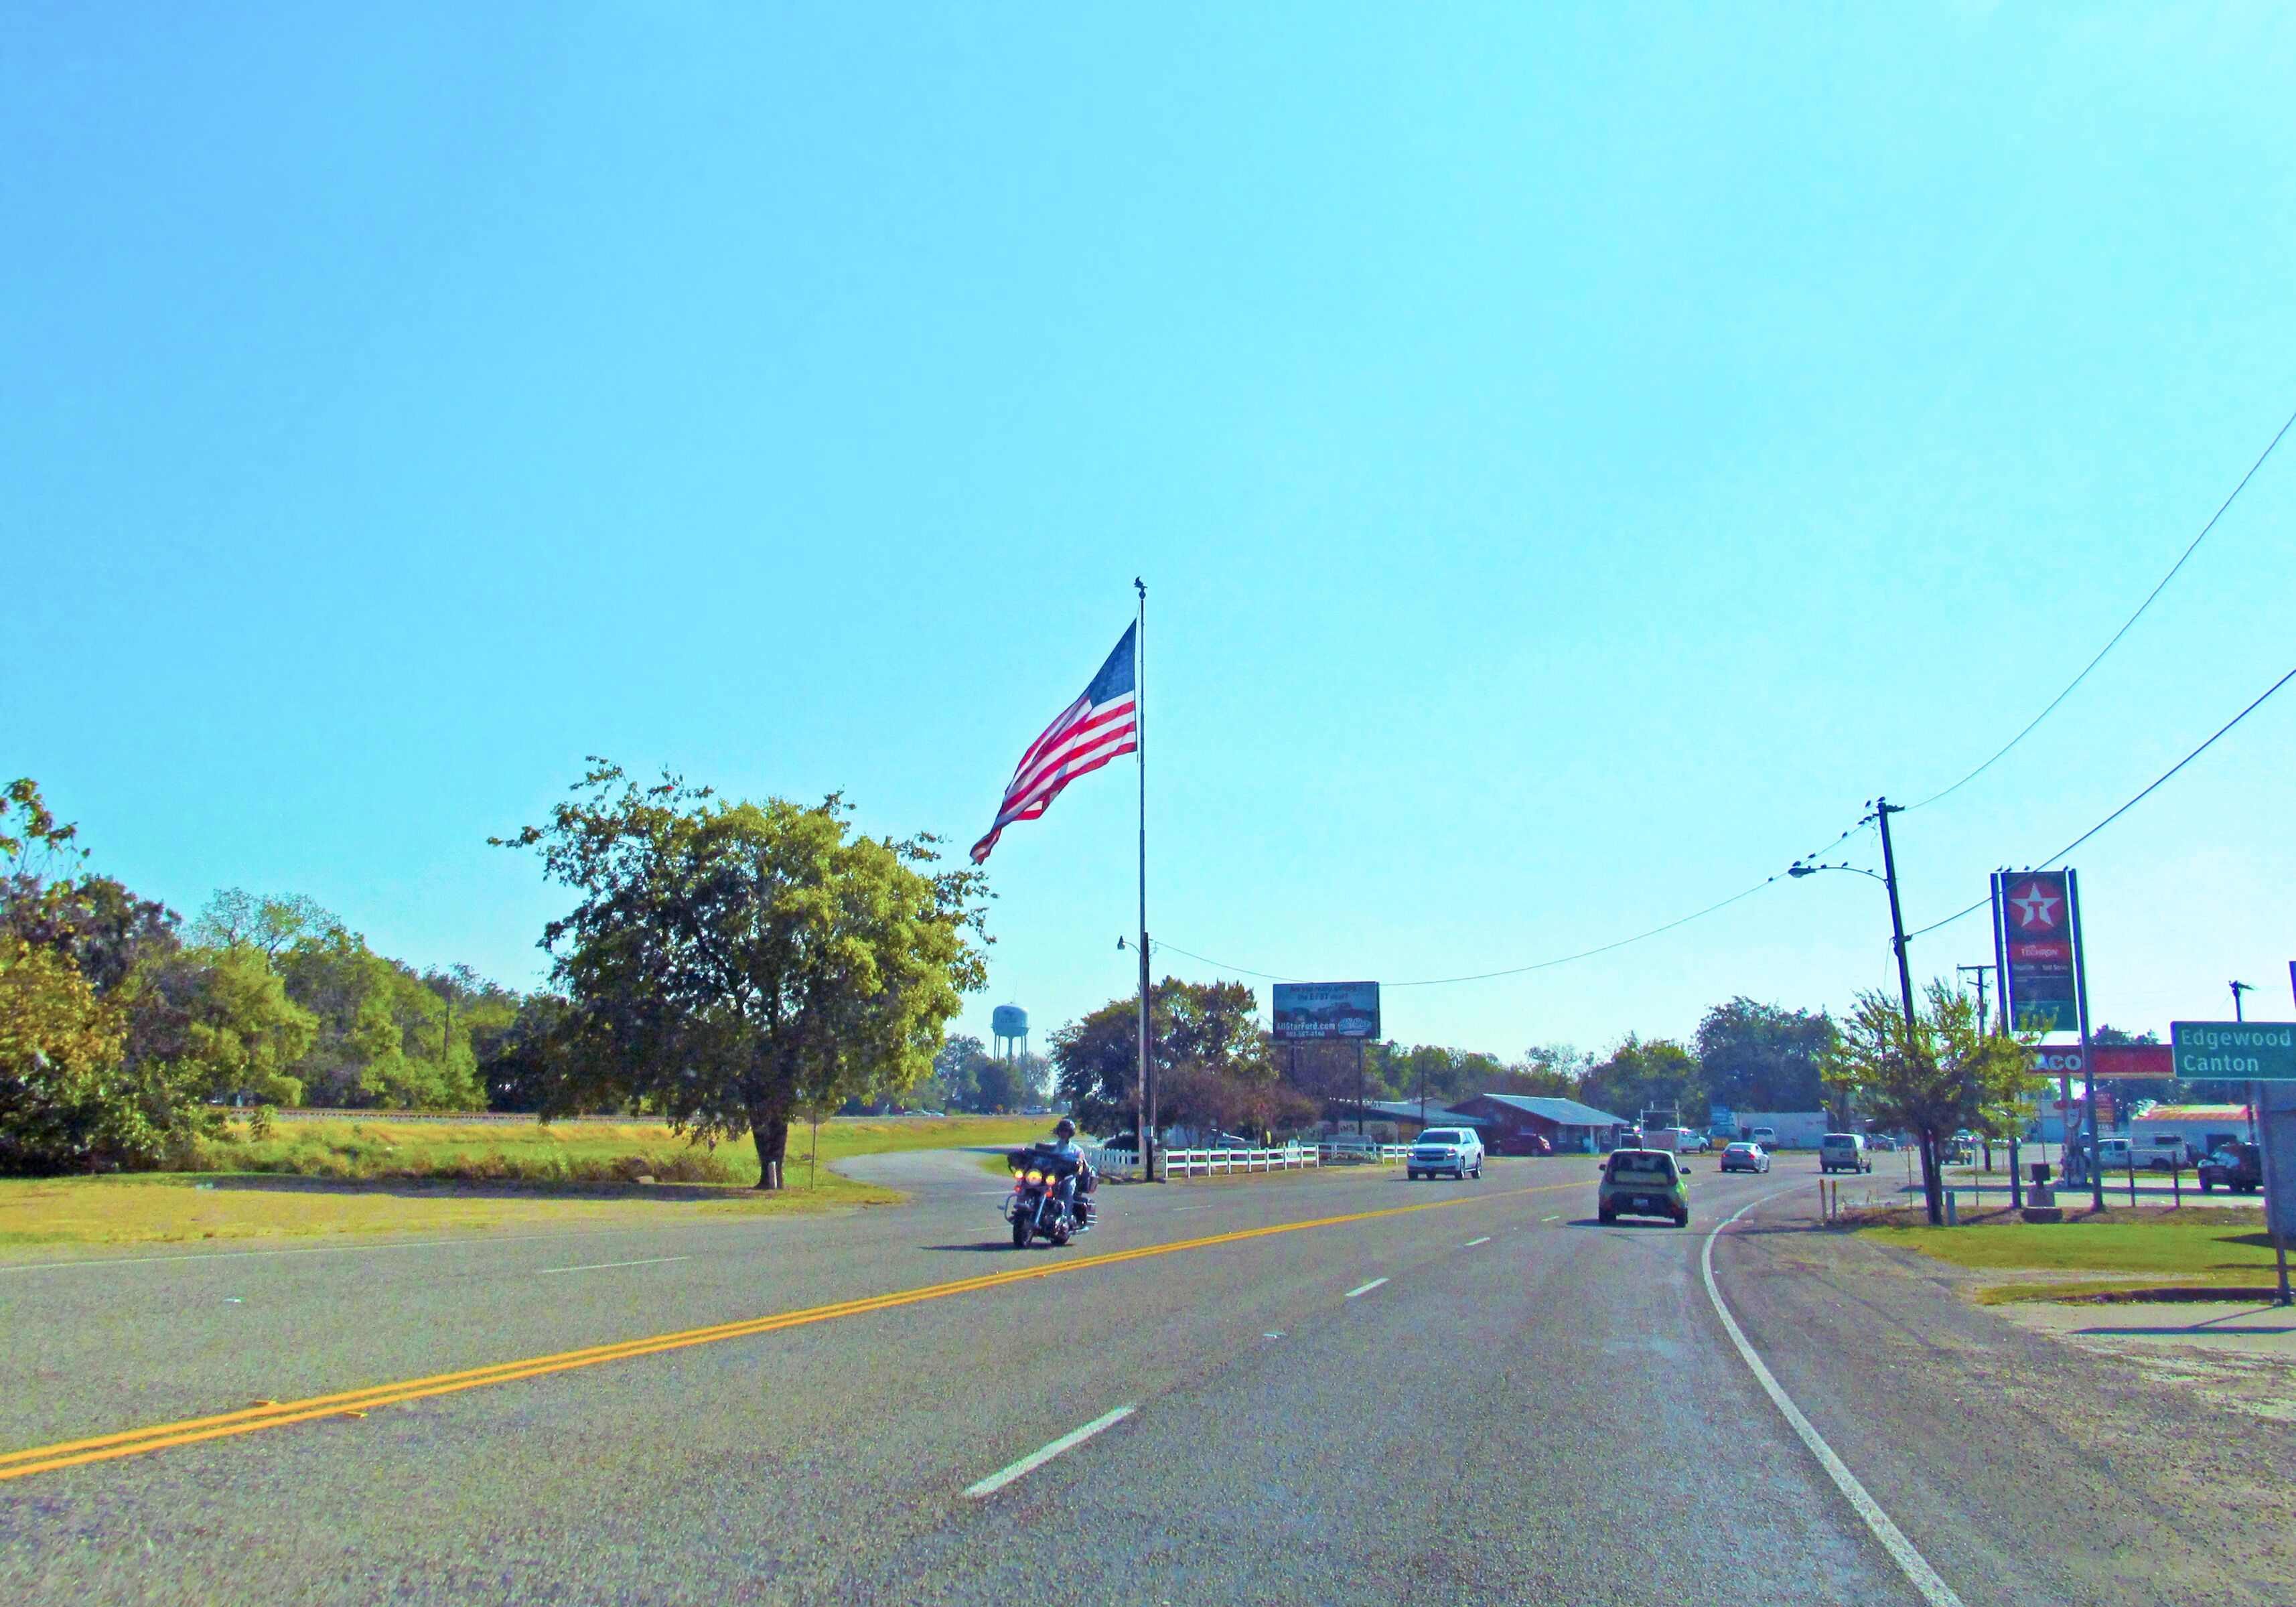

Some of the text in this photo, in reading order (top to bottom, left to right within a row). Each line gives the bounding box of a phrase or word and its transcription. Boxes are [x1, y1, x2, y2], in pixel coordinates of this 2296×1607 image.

[2181, 1028, 2292, 1049] Edgewood
[2029, 1053, 2082, 1071] ACO
[2183, 1055, 2259, 1071] Canton
